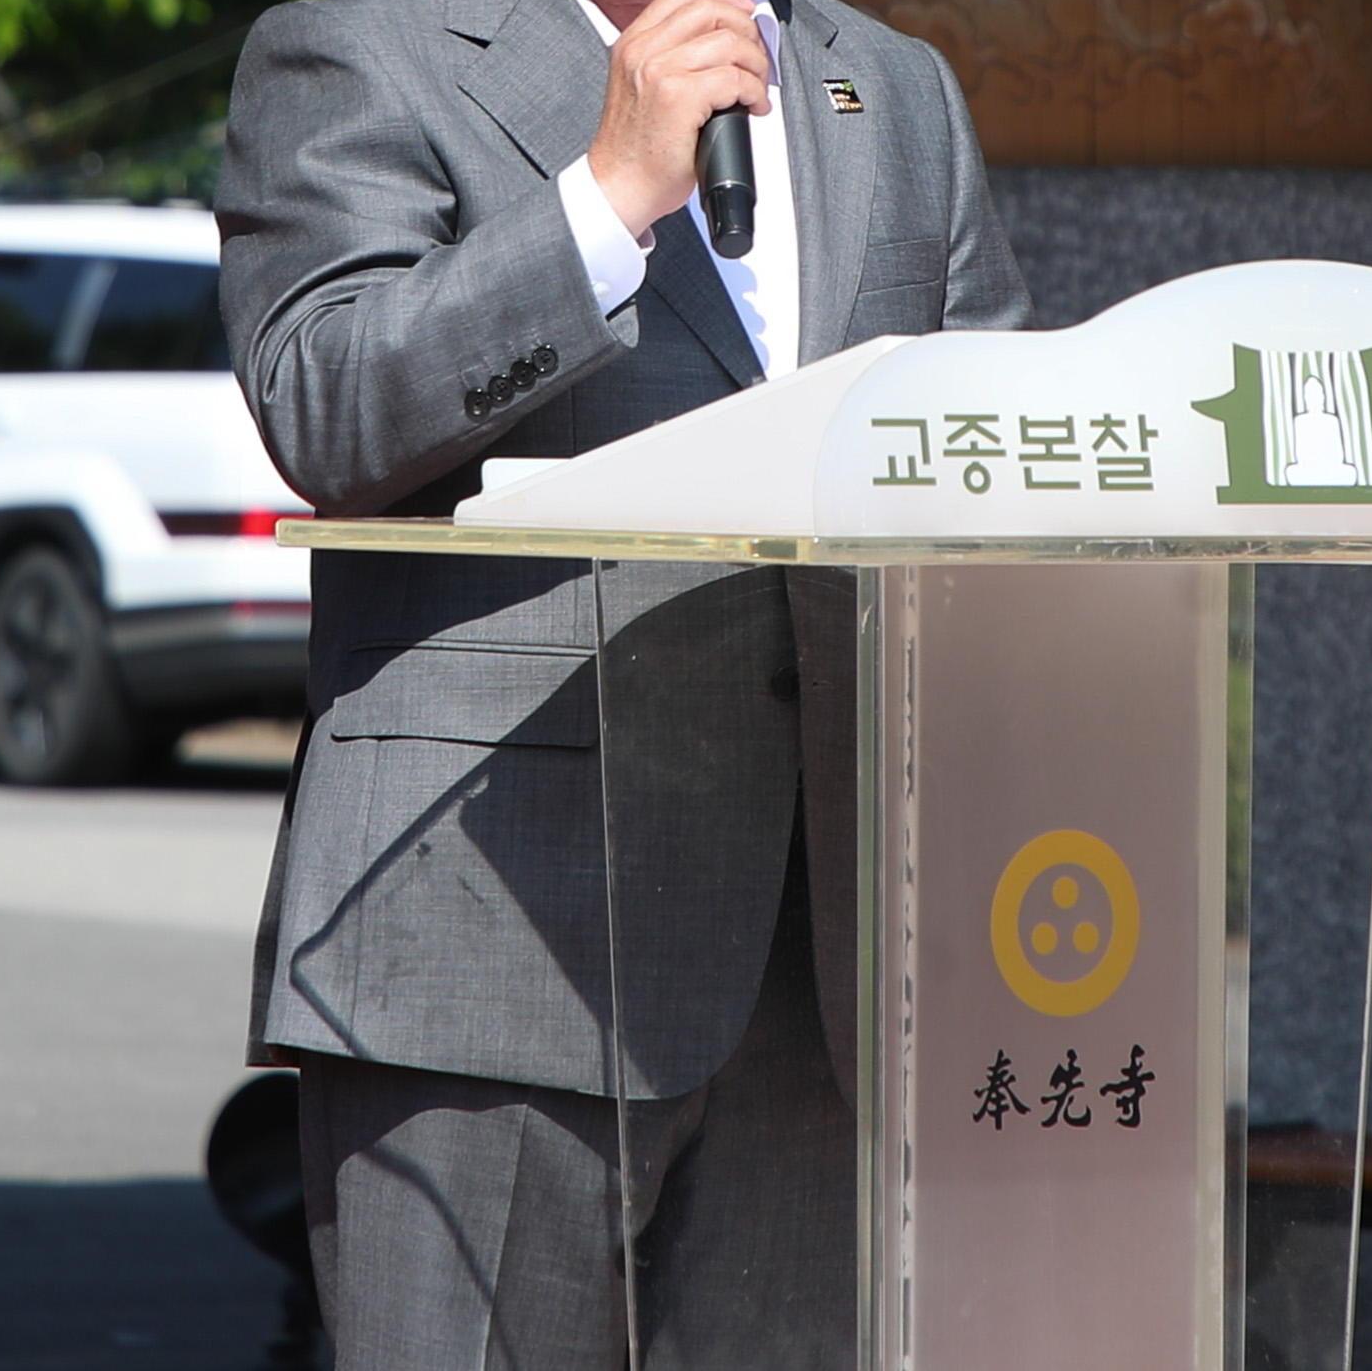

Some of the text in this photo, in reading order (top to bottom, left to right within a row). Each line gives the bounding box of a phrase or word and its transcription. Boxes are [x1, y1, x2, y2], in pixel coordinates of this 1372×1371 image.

[871, 413, 1159, 495] 교종본찰
[972, 1043, 1156, 1130] 奉先寺
